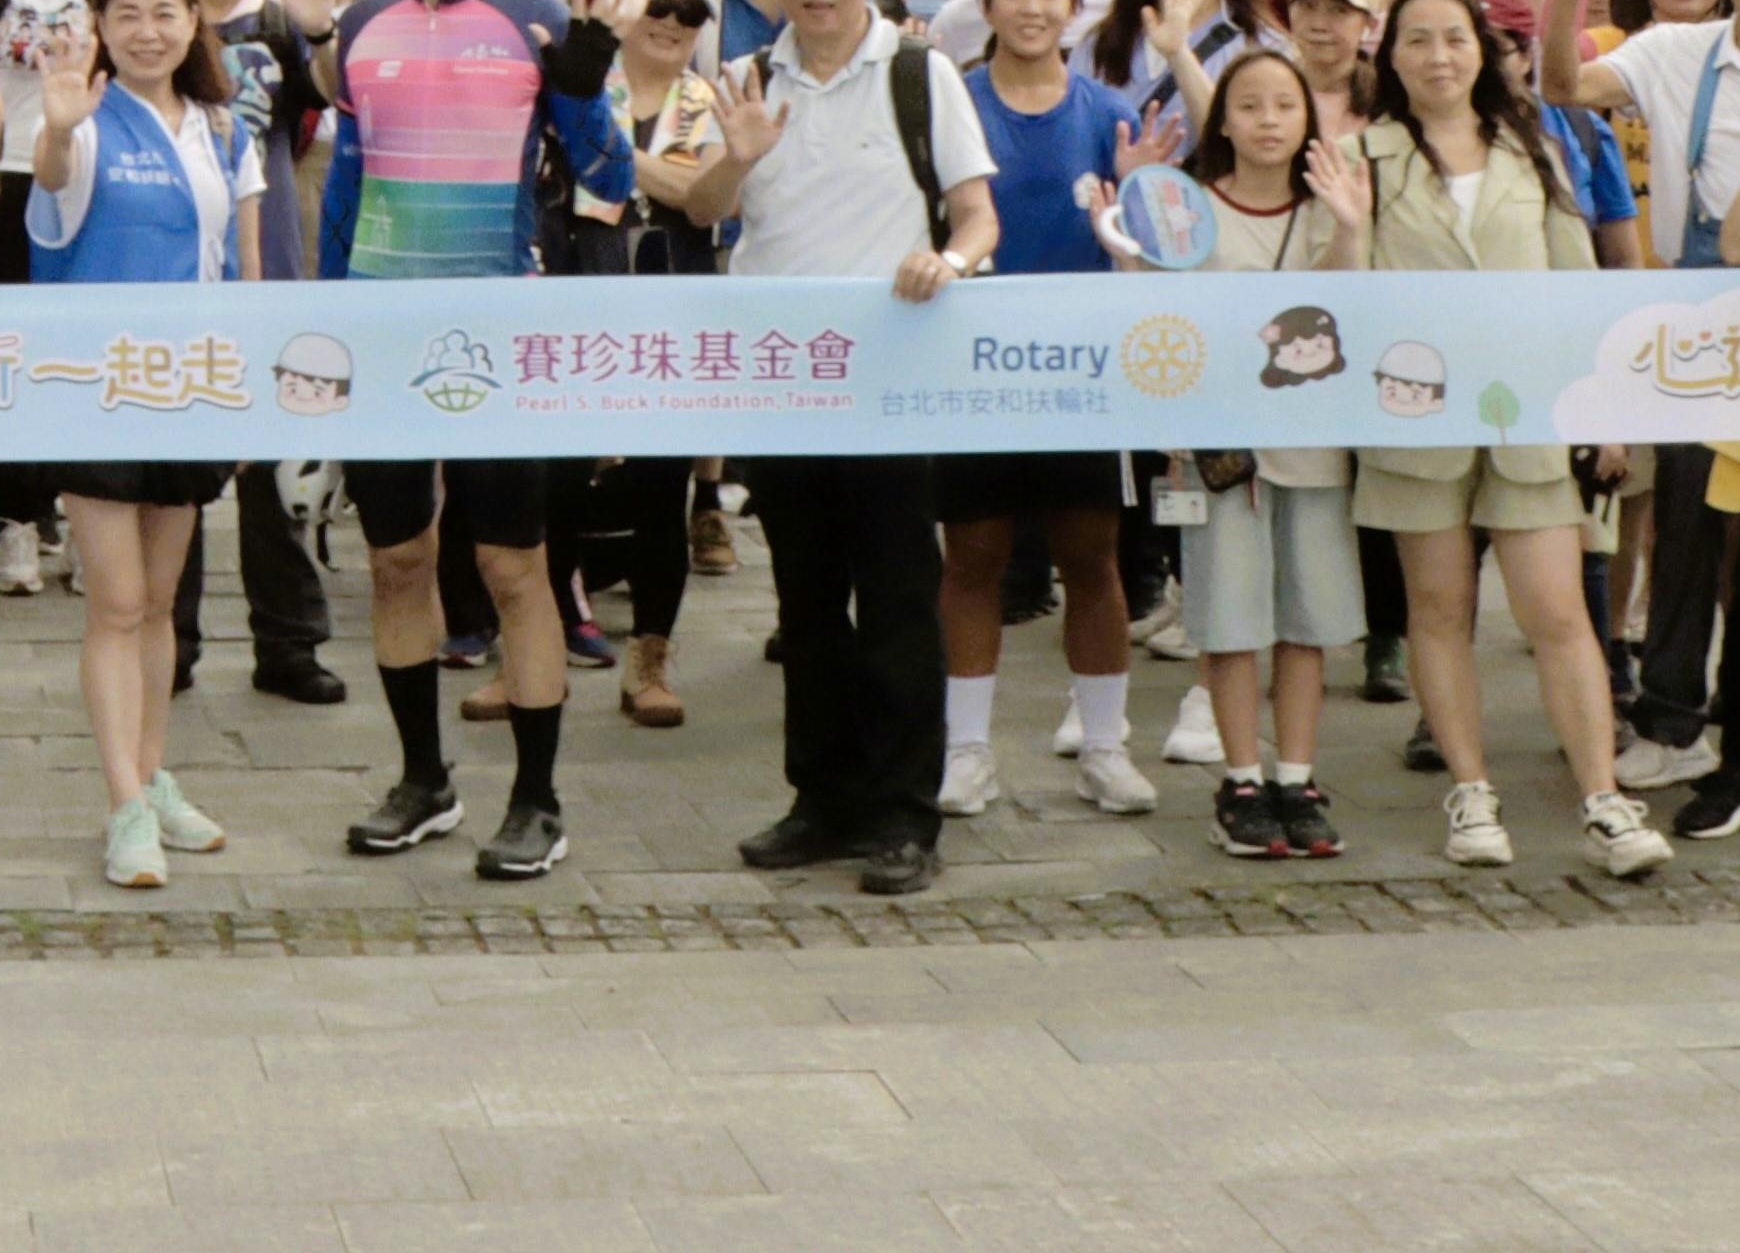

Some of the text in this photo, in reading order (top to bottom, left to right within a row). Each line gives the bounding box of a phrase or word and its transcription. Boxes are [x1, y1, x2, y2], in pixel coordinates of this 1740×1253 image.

[512, 328, 856, 384] 賽珍珠基金會
[972, 337, 1110, 379] Rotary
[515, 395, 568, 412] Pearl
[601, 394, 649, 410] Buck
[659, 393, 782, 412] Foundation,
[786, 391, 854, 408] Taiwan
[880, 388, 1111, 417] 台北市安和扶輪社
